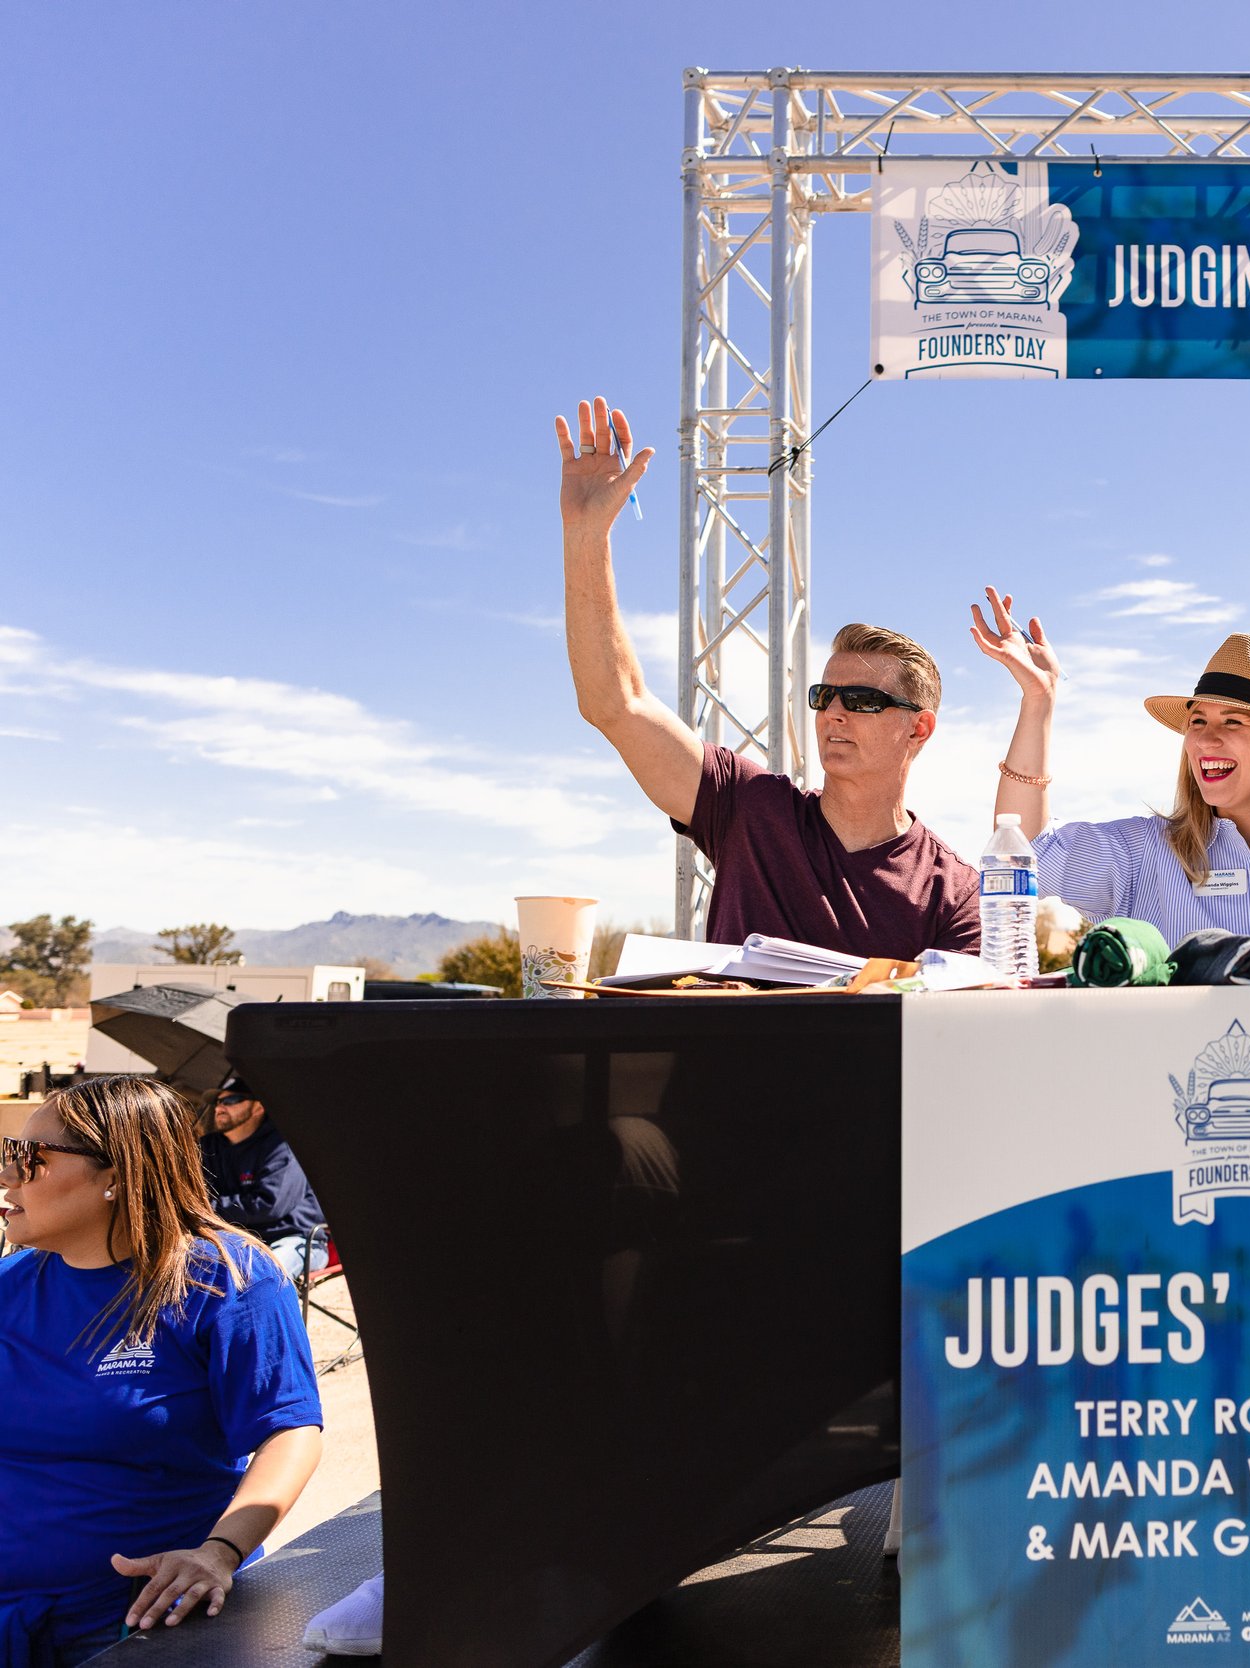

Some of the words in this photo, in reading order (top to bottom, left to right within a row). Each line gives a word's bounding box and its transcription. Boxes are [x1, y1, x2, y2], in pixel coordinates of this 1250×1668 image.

[922, 313, 942, 323] THE
[945, 311, 977, 320] TOWN
[980, 310, 995, 318] OF
[997, 311, 1043, 323] MARANA
[966, 321, 999, 330] presents
[1015, 335, 1046, 361] DAY
[1192, 1148, 1207, 1156] THE
[1210, 1146, 1234, 1154] TOWN
[97, 1360, 137, 1372] MARANA
[138, 1360, 155, 1368] AZ
[1074, 1398, 1198, 1438] TERRY
[1026, 1457, 1234, 1500] AMANDA
[1025, 1524, 1056, 1561] &
[1069, 1519, 1199, 1559] MARK
[1166, 1632, 1215, 1644] MARANA
[1216, 1632, 1231, 1643] AZ
